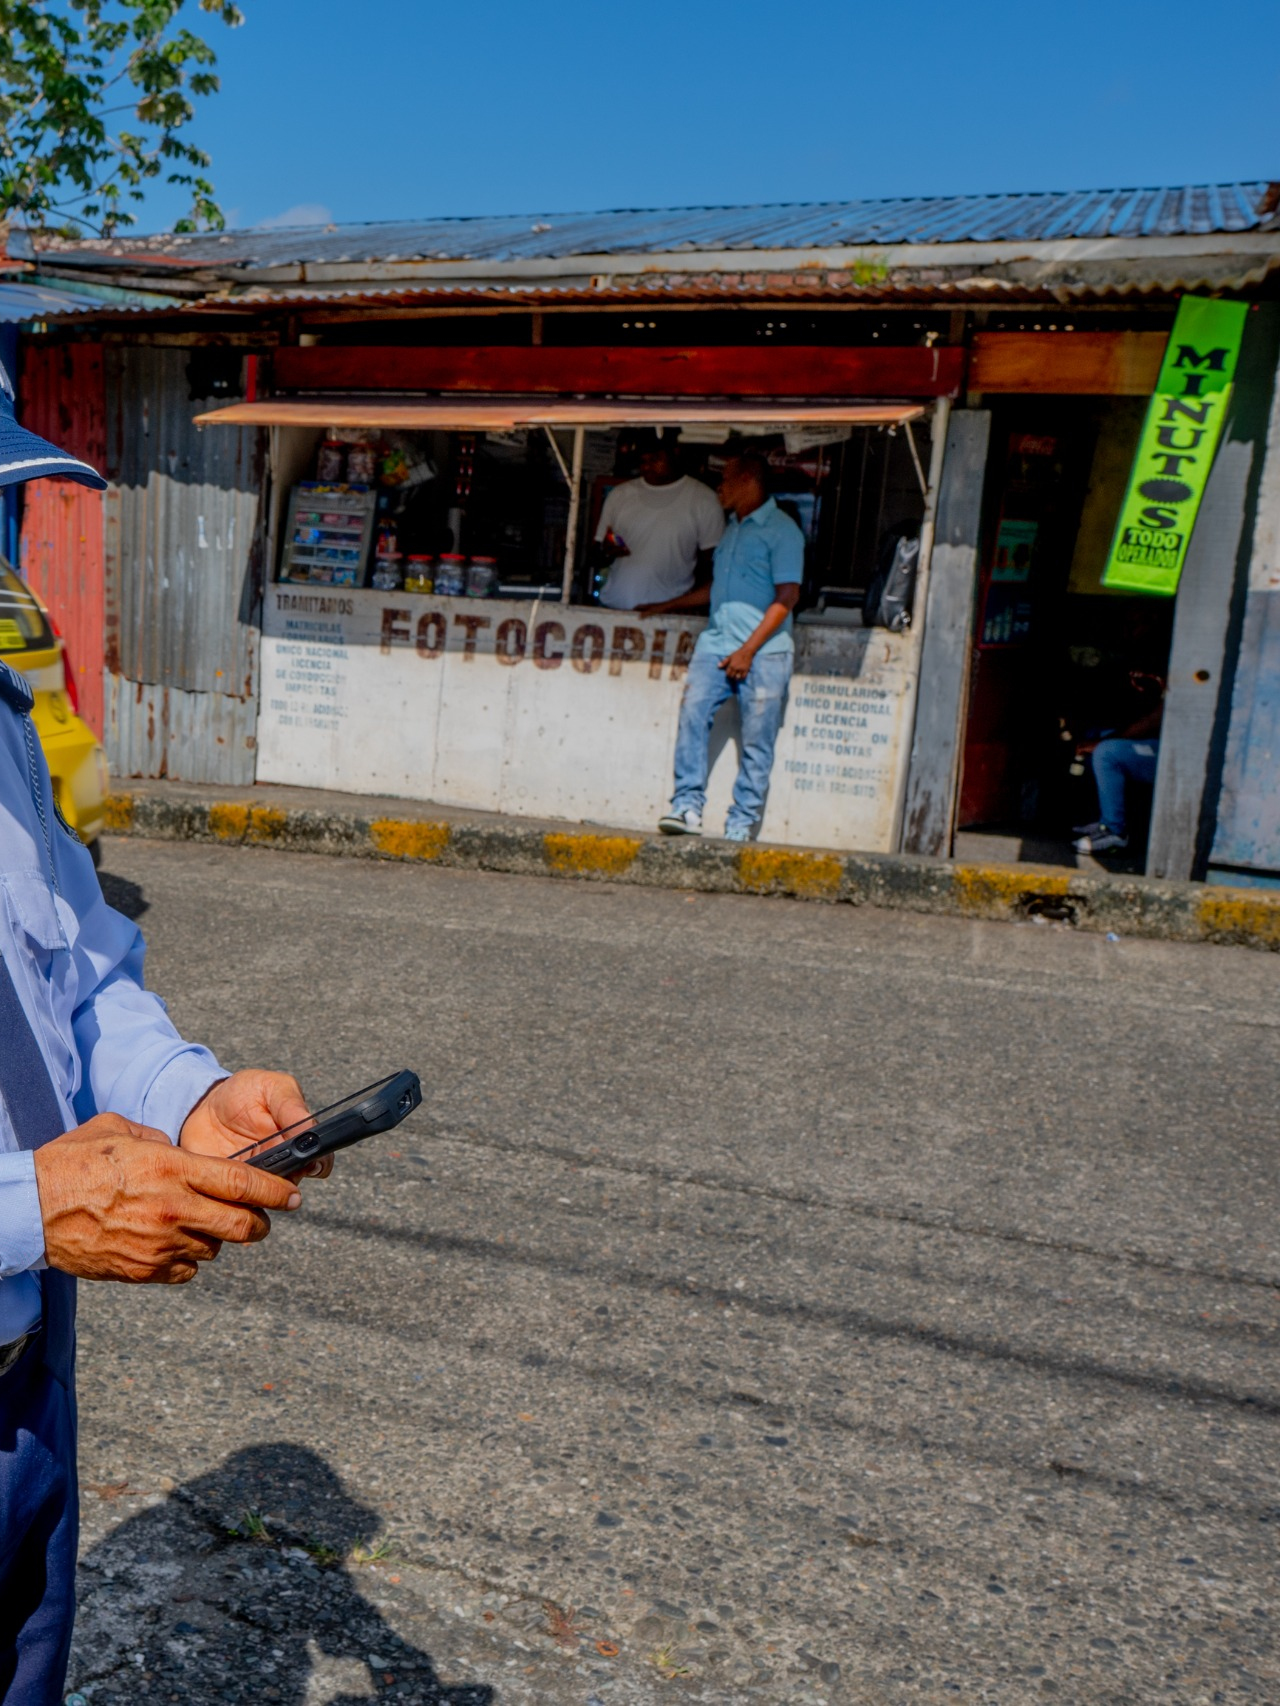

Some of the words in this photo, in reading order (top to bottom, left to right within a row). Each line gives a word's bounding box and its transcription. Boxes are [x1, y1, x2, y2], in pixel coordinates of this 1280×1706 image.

[1128, 530, 1179, 550] TODO
[276, 594, 354, 615] TRAMITAMOS
[795, 697, 831, 711] UNICO
[834, 699, 892, 716] NACIONAL
[814, 713, 868, 728] LICENCIA
[794, 725, 808, 737] DE
